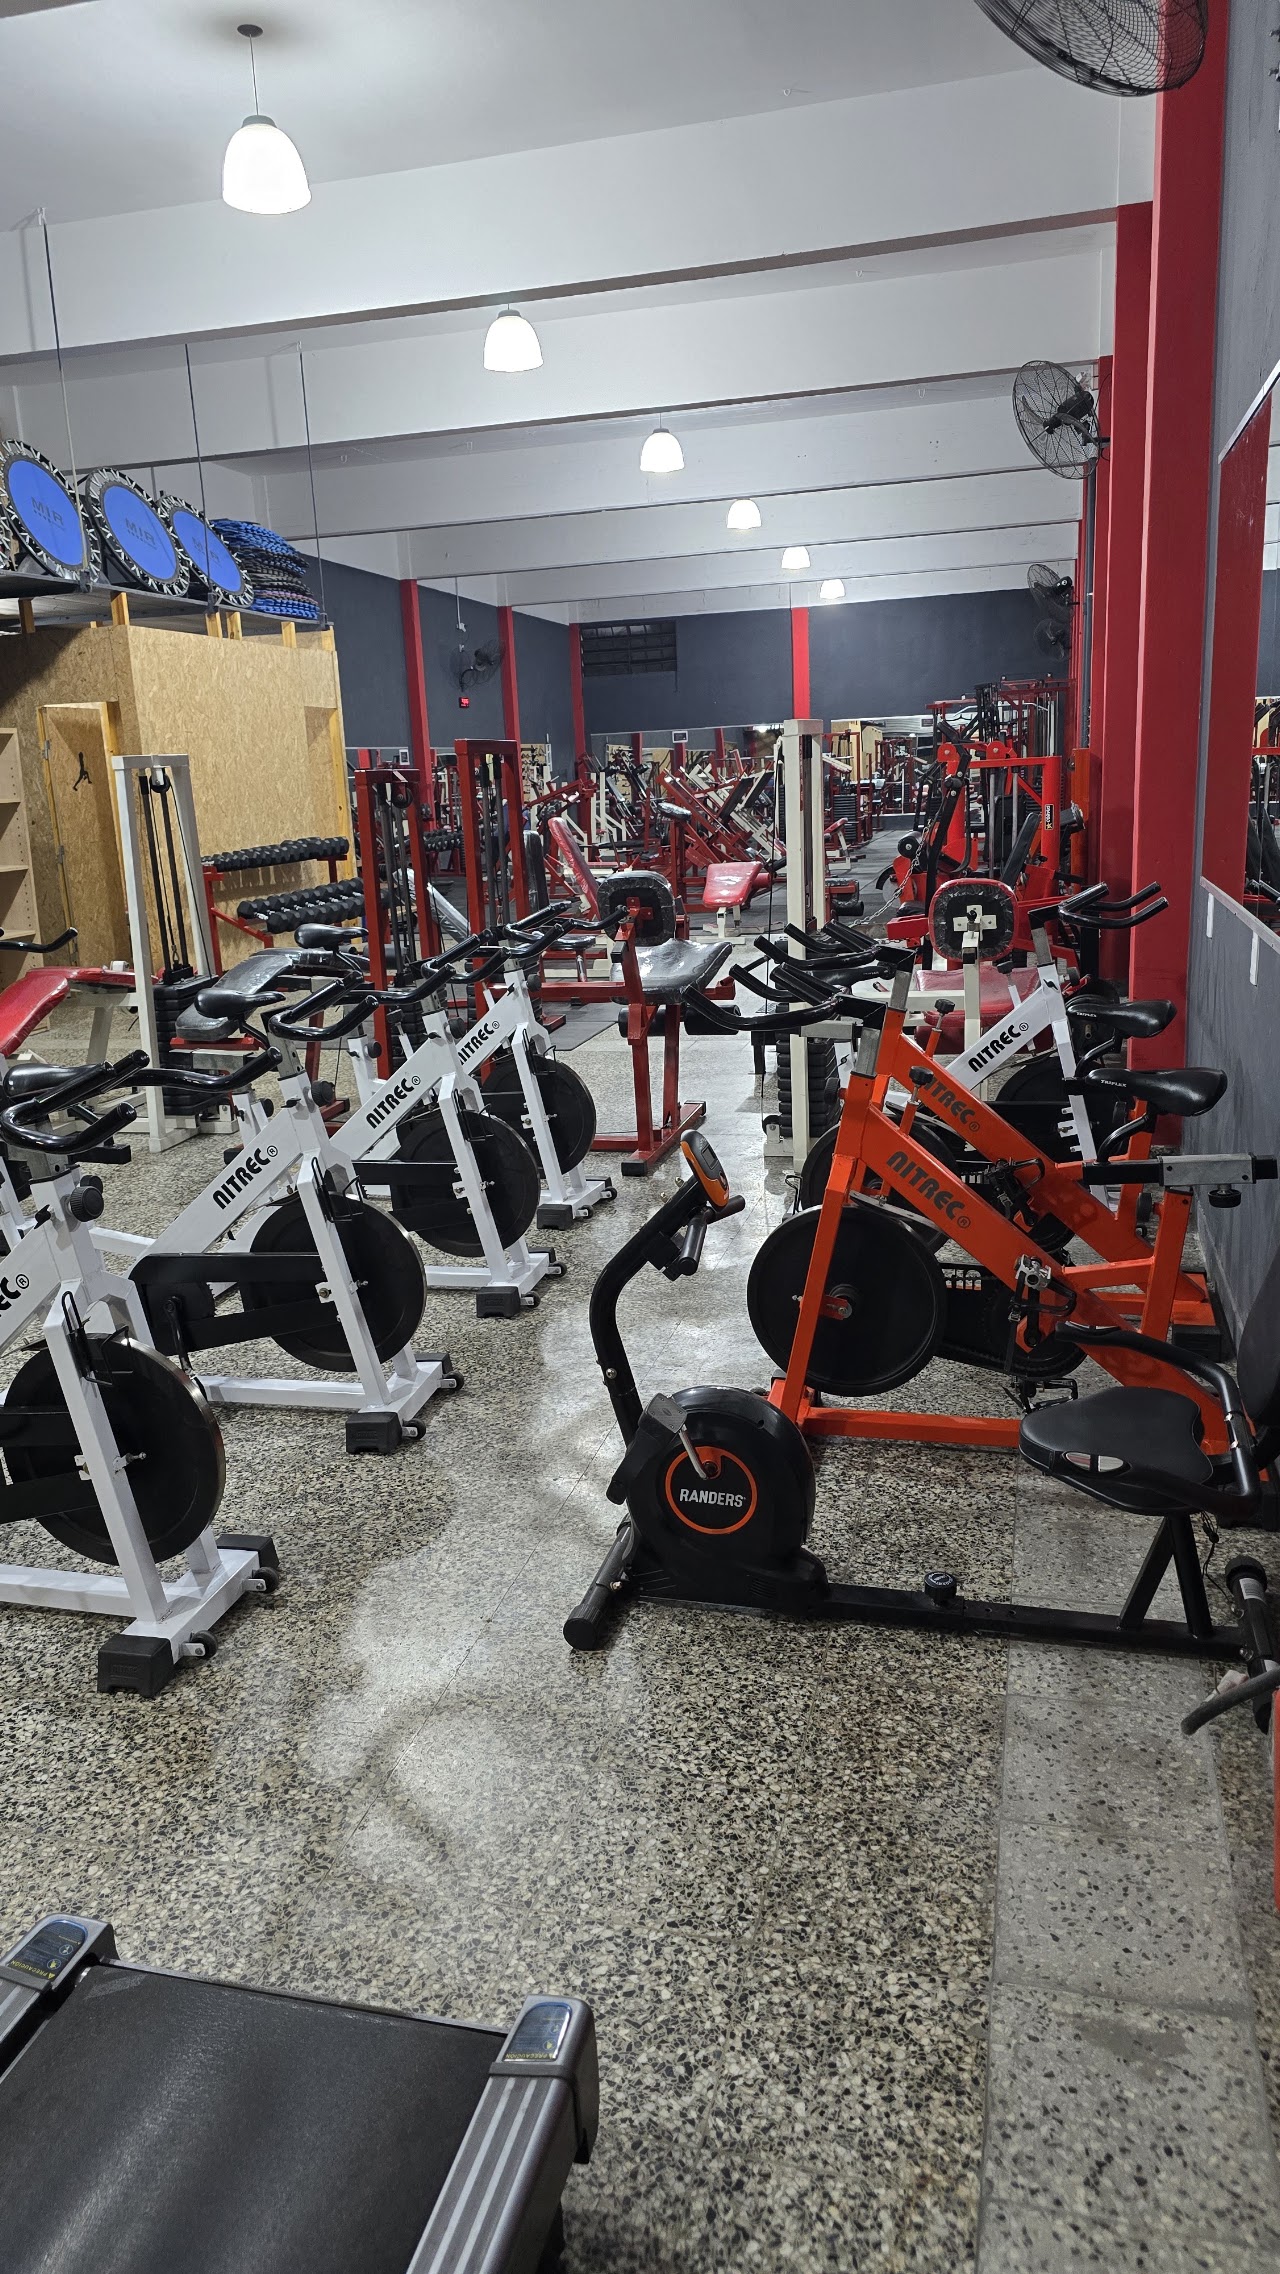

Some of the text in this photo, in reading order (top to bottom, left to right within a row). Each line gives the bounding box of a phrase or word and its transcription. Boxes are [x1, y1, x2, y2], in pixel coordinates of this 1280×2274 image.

[968, 1024, 1021, 1073] NITREC
[366, 1077, 415, 1130] NITREC
[923, 1075, 976, 1124] ITREC
[212, 1147, 271, 1210] NITREC
[886, 1150, 965, 1220] NITREC
[679, 1488, 744, 1508] RANDERS
